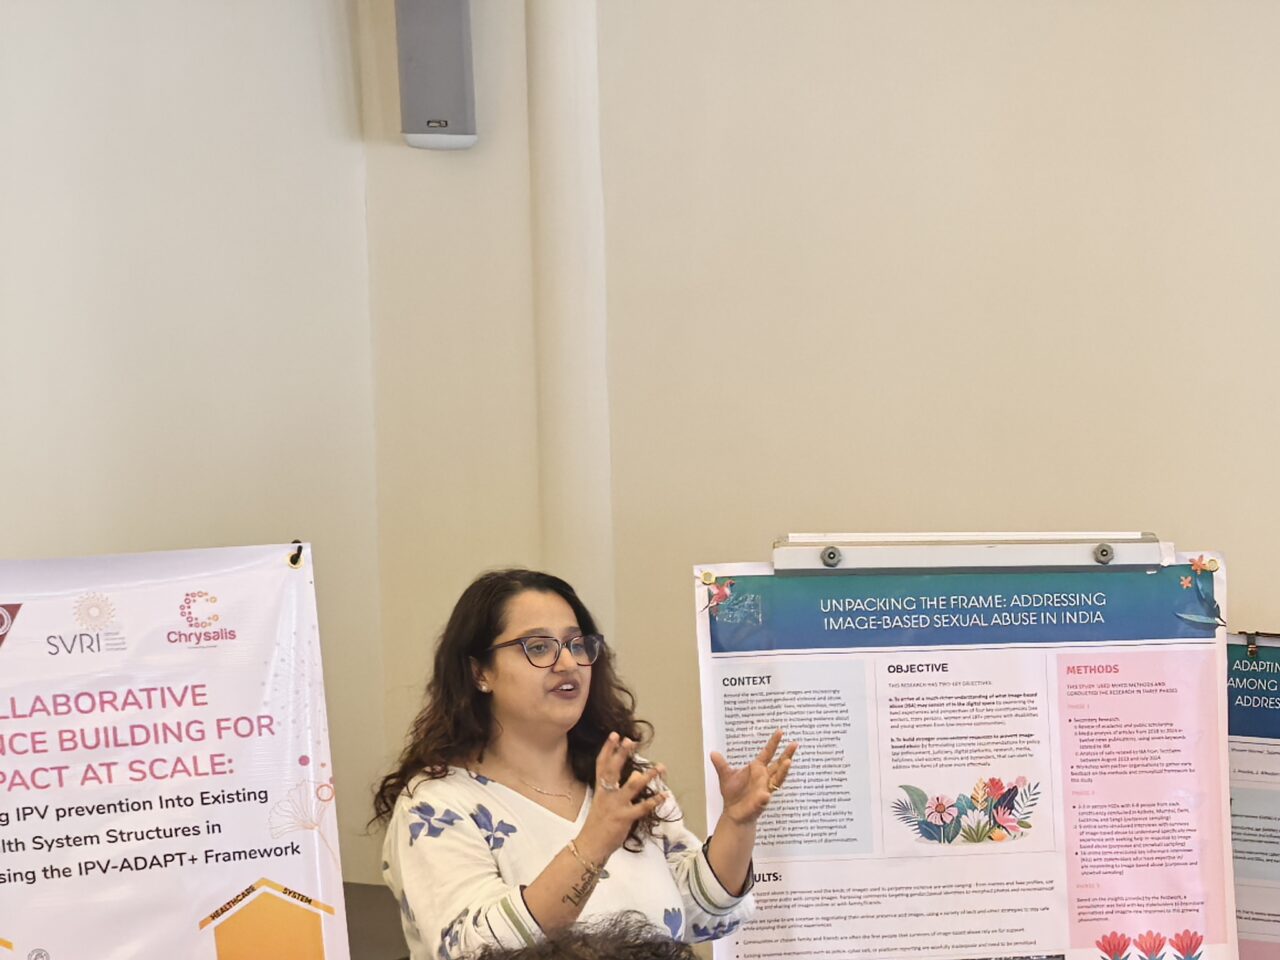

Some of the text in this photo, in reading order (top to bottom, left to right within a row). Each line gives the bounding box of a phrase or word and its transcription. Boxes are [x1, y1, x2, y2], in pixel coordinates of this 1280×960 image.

[820, 592, 1106, 613] UNPACKING THE FRAME: ADDRESSING
[824, 611, 1104, 630] IMAGE-BASED SEXUAL ABUSE IN INDIA
[46, 633, 101, 655] SVRI
[166, 628, 237, 645] Chrysalis
[887, 662, 949, 674] OBJECTIVE
[1066, 664, 1120, 675] METHODS
[722, 675, 772, 687] CONTEXT
[1227, 677, 1278, 691] AMONG
[58, 720, 206, 751] BUILDING
[216, 714, 276, 741] FOR
[80, 762, 118, 786] AT
[128, 753, 234, 782] SCALE:
[16, 805, 49, 821] IPV
[55, 796, 153, 822] prevention
[158, 794, 195, 810] Into
[200, 788, 269, 807] Existing
[32, 834, 100, 852] System
[106, 823, 201, 844] Structures
[206, 820, 222, 836] in
[42, 864, 72, 879] the
[78, 852, 199, 876] IPV-ADAPT+
[204, 841, 301, 864] Framework
[209, 884, 256, 921] HEALTHCARE
[282, 887, 313, 905] SYSTEM
